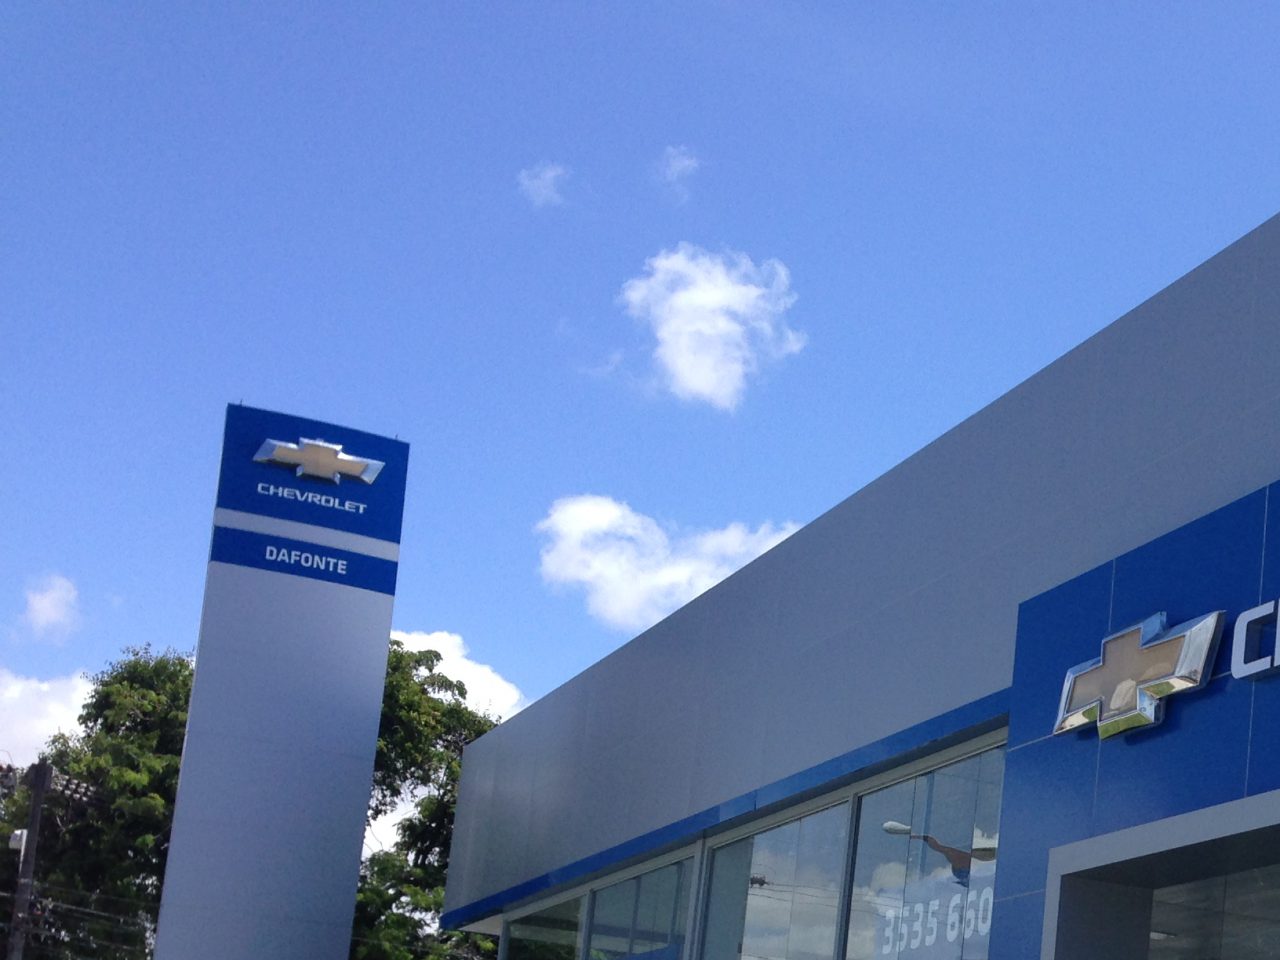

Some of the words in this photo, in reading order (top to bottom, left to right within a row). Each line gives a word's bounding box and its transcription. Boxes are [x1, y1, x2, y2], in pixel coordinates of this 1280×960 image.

[257, 482, 367, 514] CHEVROLET
[265, 545, 347, 575] DAFONTE
[881, 898, 940, 955] 3535
